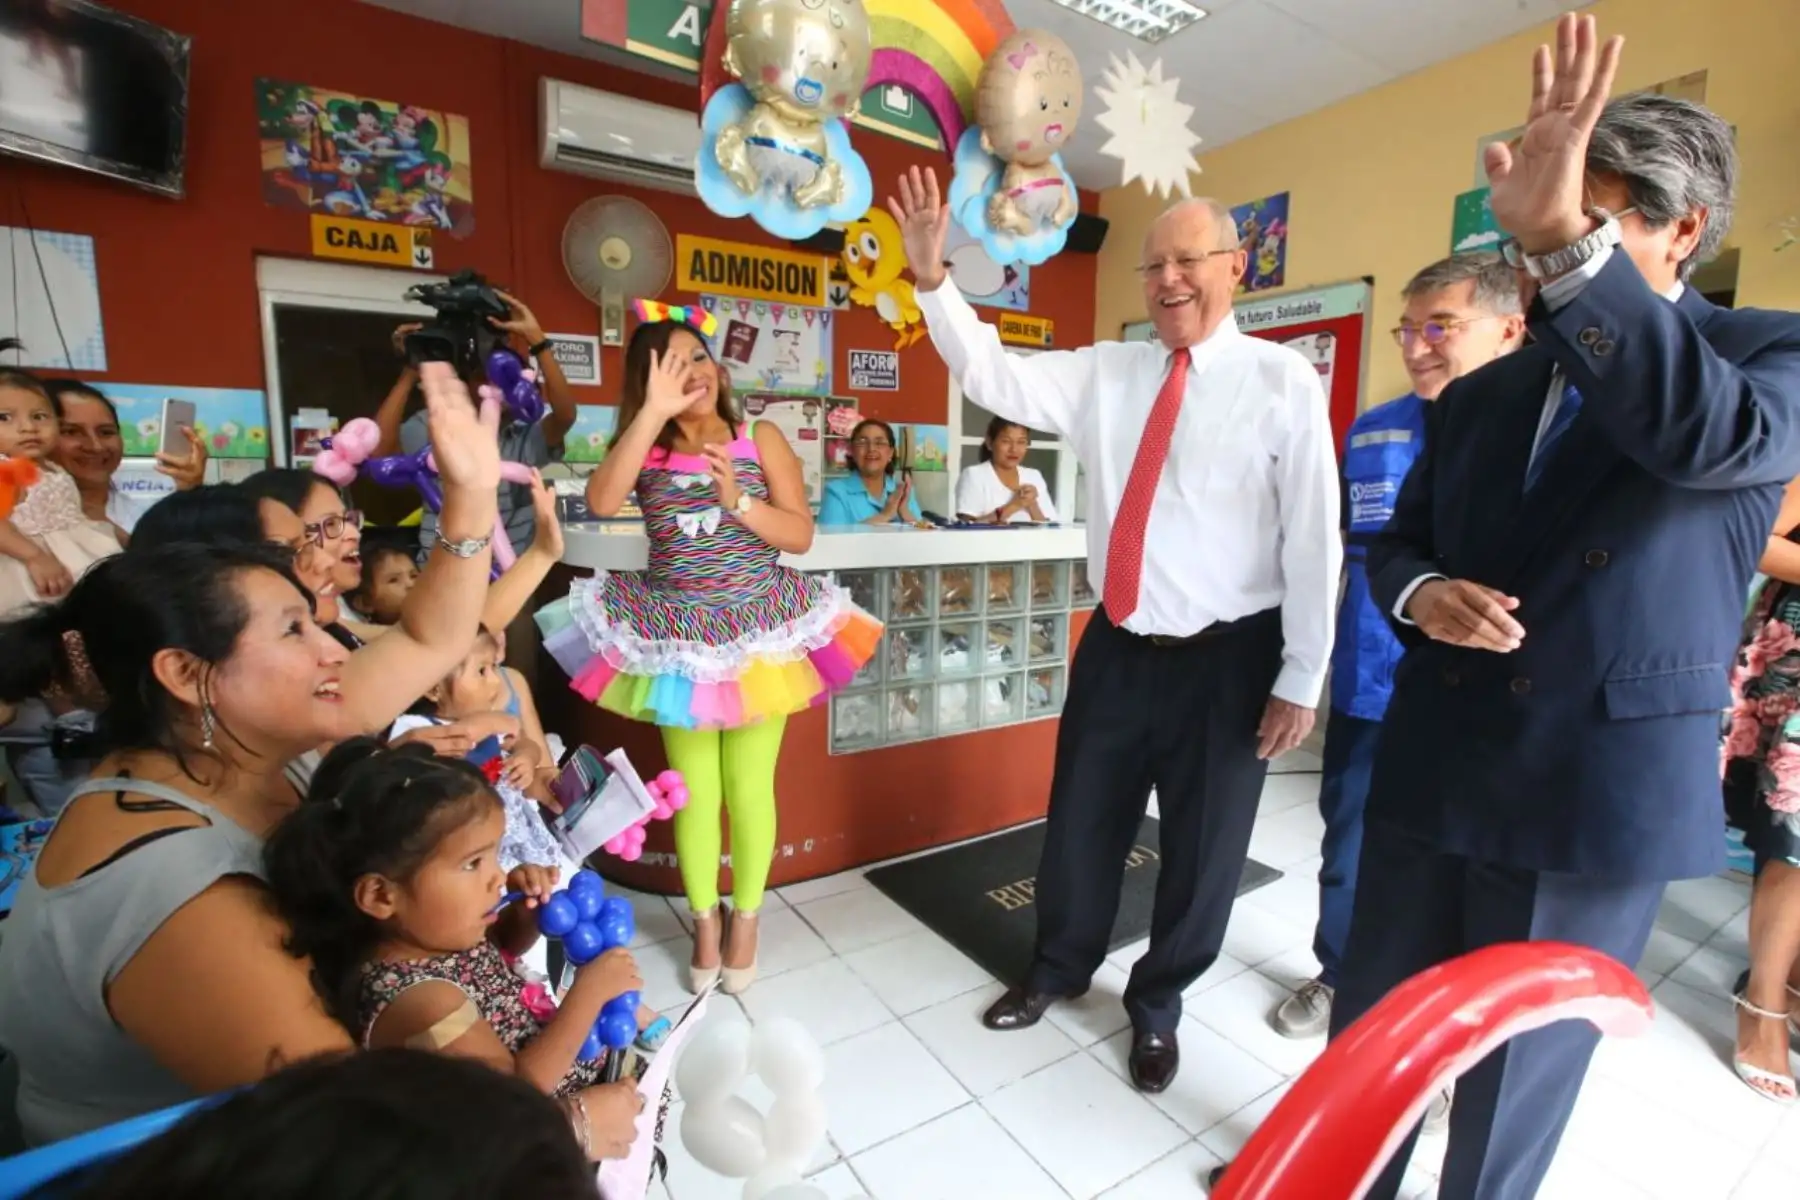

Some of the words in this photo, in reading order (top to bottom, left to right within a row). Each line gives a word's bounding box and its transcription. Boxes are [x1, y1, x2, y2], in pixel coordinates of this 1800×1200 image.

[326, 226, 400, 254] CAJA
[689, 248, 817, 298] ADMISION
[1276, 299, 1322, 320] Saludable
[552, 342, 585, 353] FORO
[852, 353, 896, 371] AFORO
